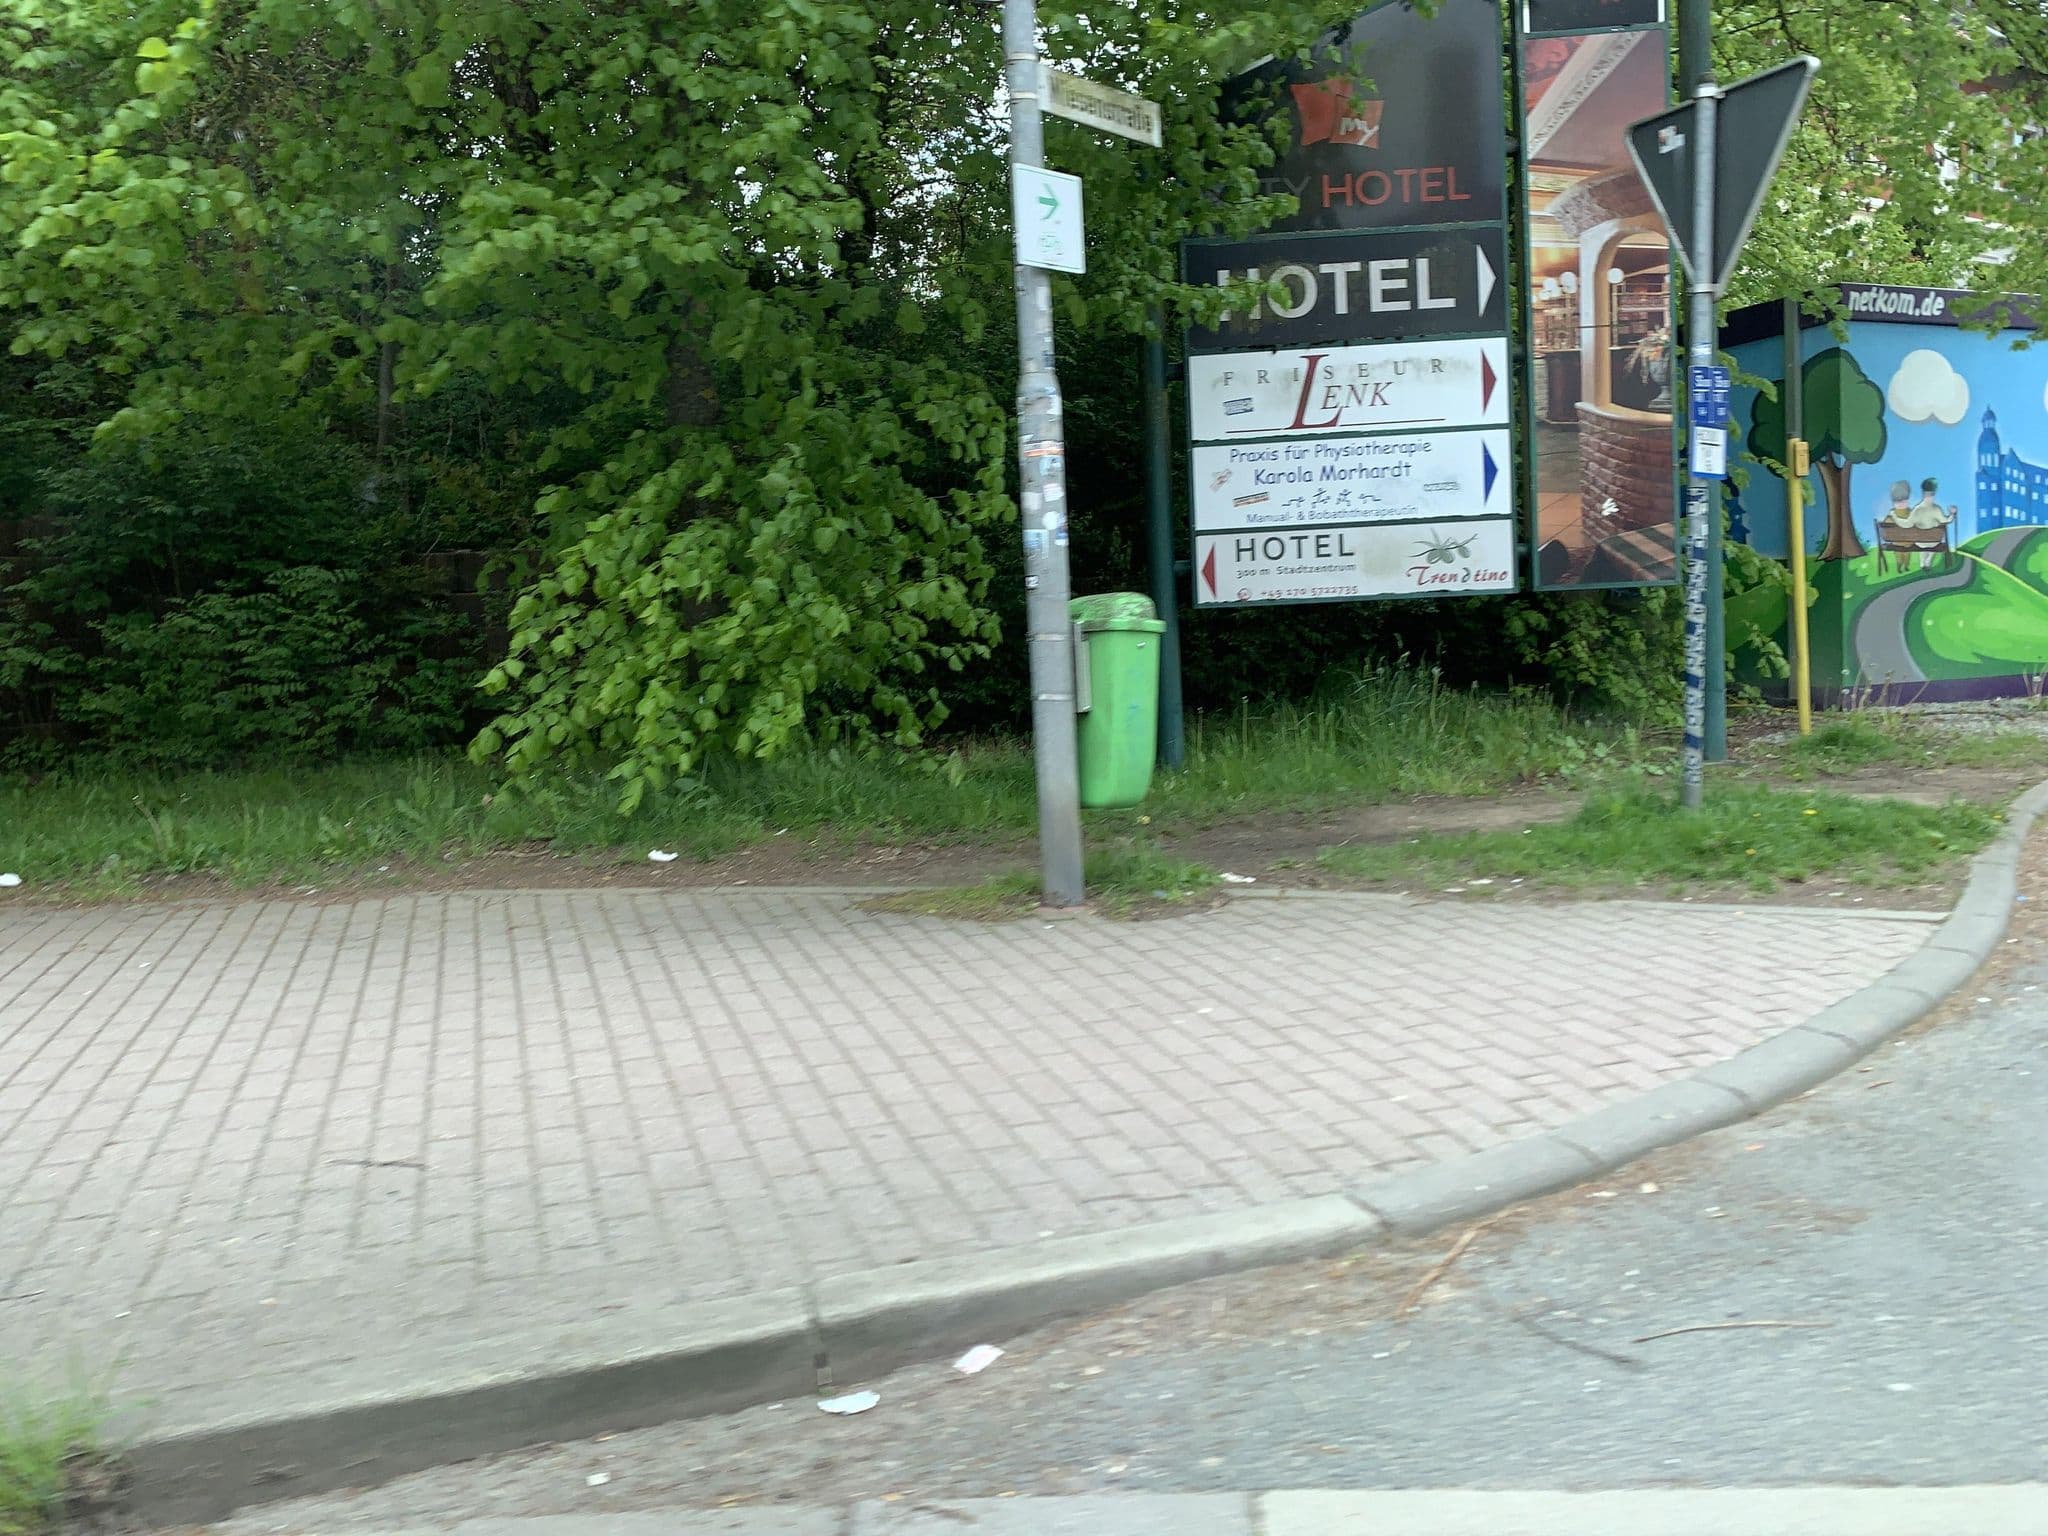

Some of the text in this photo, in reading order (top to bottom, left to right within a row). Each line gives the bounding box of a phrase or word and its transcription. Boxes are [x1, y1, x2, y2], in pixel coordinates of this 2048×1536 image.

[1321, 166, 1472, 207] HOTEL
[1847, 286, 1946, 317] netkom.de
[1222, 358, 1445, 387] FRISEUR
[1230, 438, 1432, 463] Praxis für Physiotherapie
[1254, 460, 1413, 486] Karola Morhardt
[1235, 533, 1355, 562] HOTEL
[1275, 563, 1356, 576] Stadtzentrum
